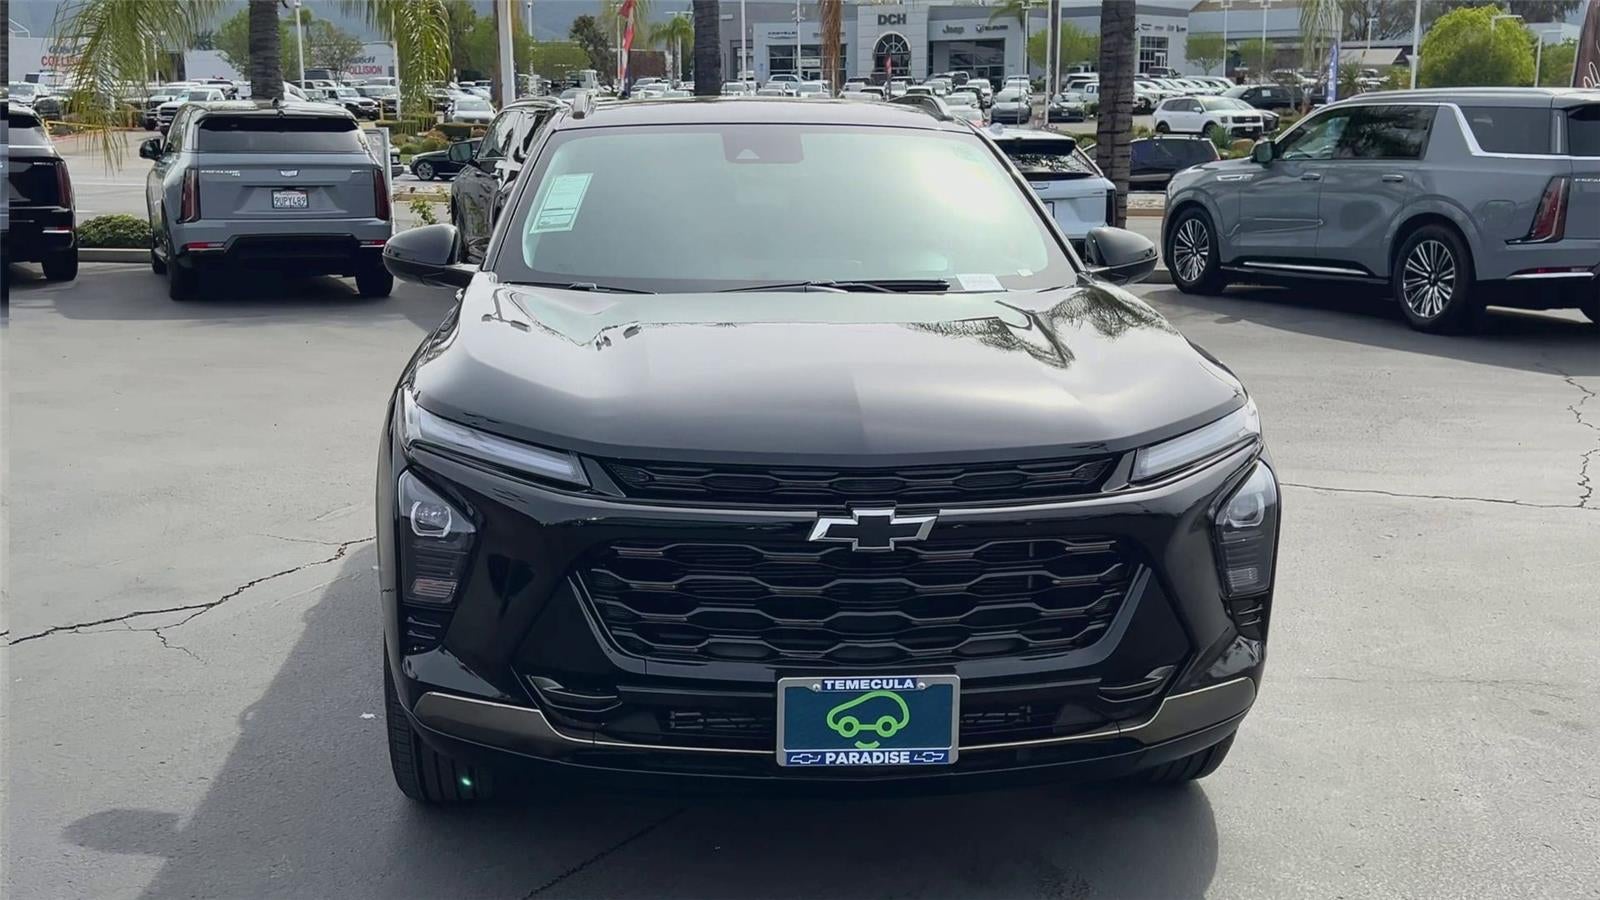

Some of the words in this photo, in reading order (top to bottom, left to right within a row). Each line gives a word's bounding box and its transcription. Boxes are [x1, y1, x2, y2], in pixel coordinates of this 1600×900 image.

[878, 13, 907, 26] DCH
[346, 65, 383, 75] OLLISION
[824, 678, 915, 690] TEMECULA
[825, 751, 910, 765] PARADISE
